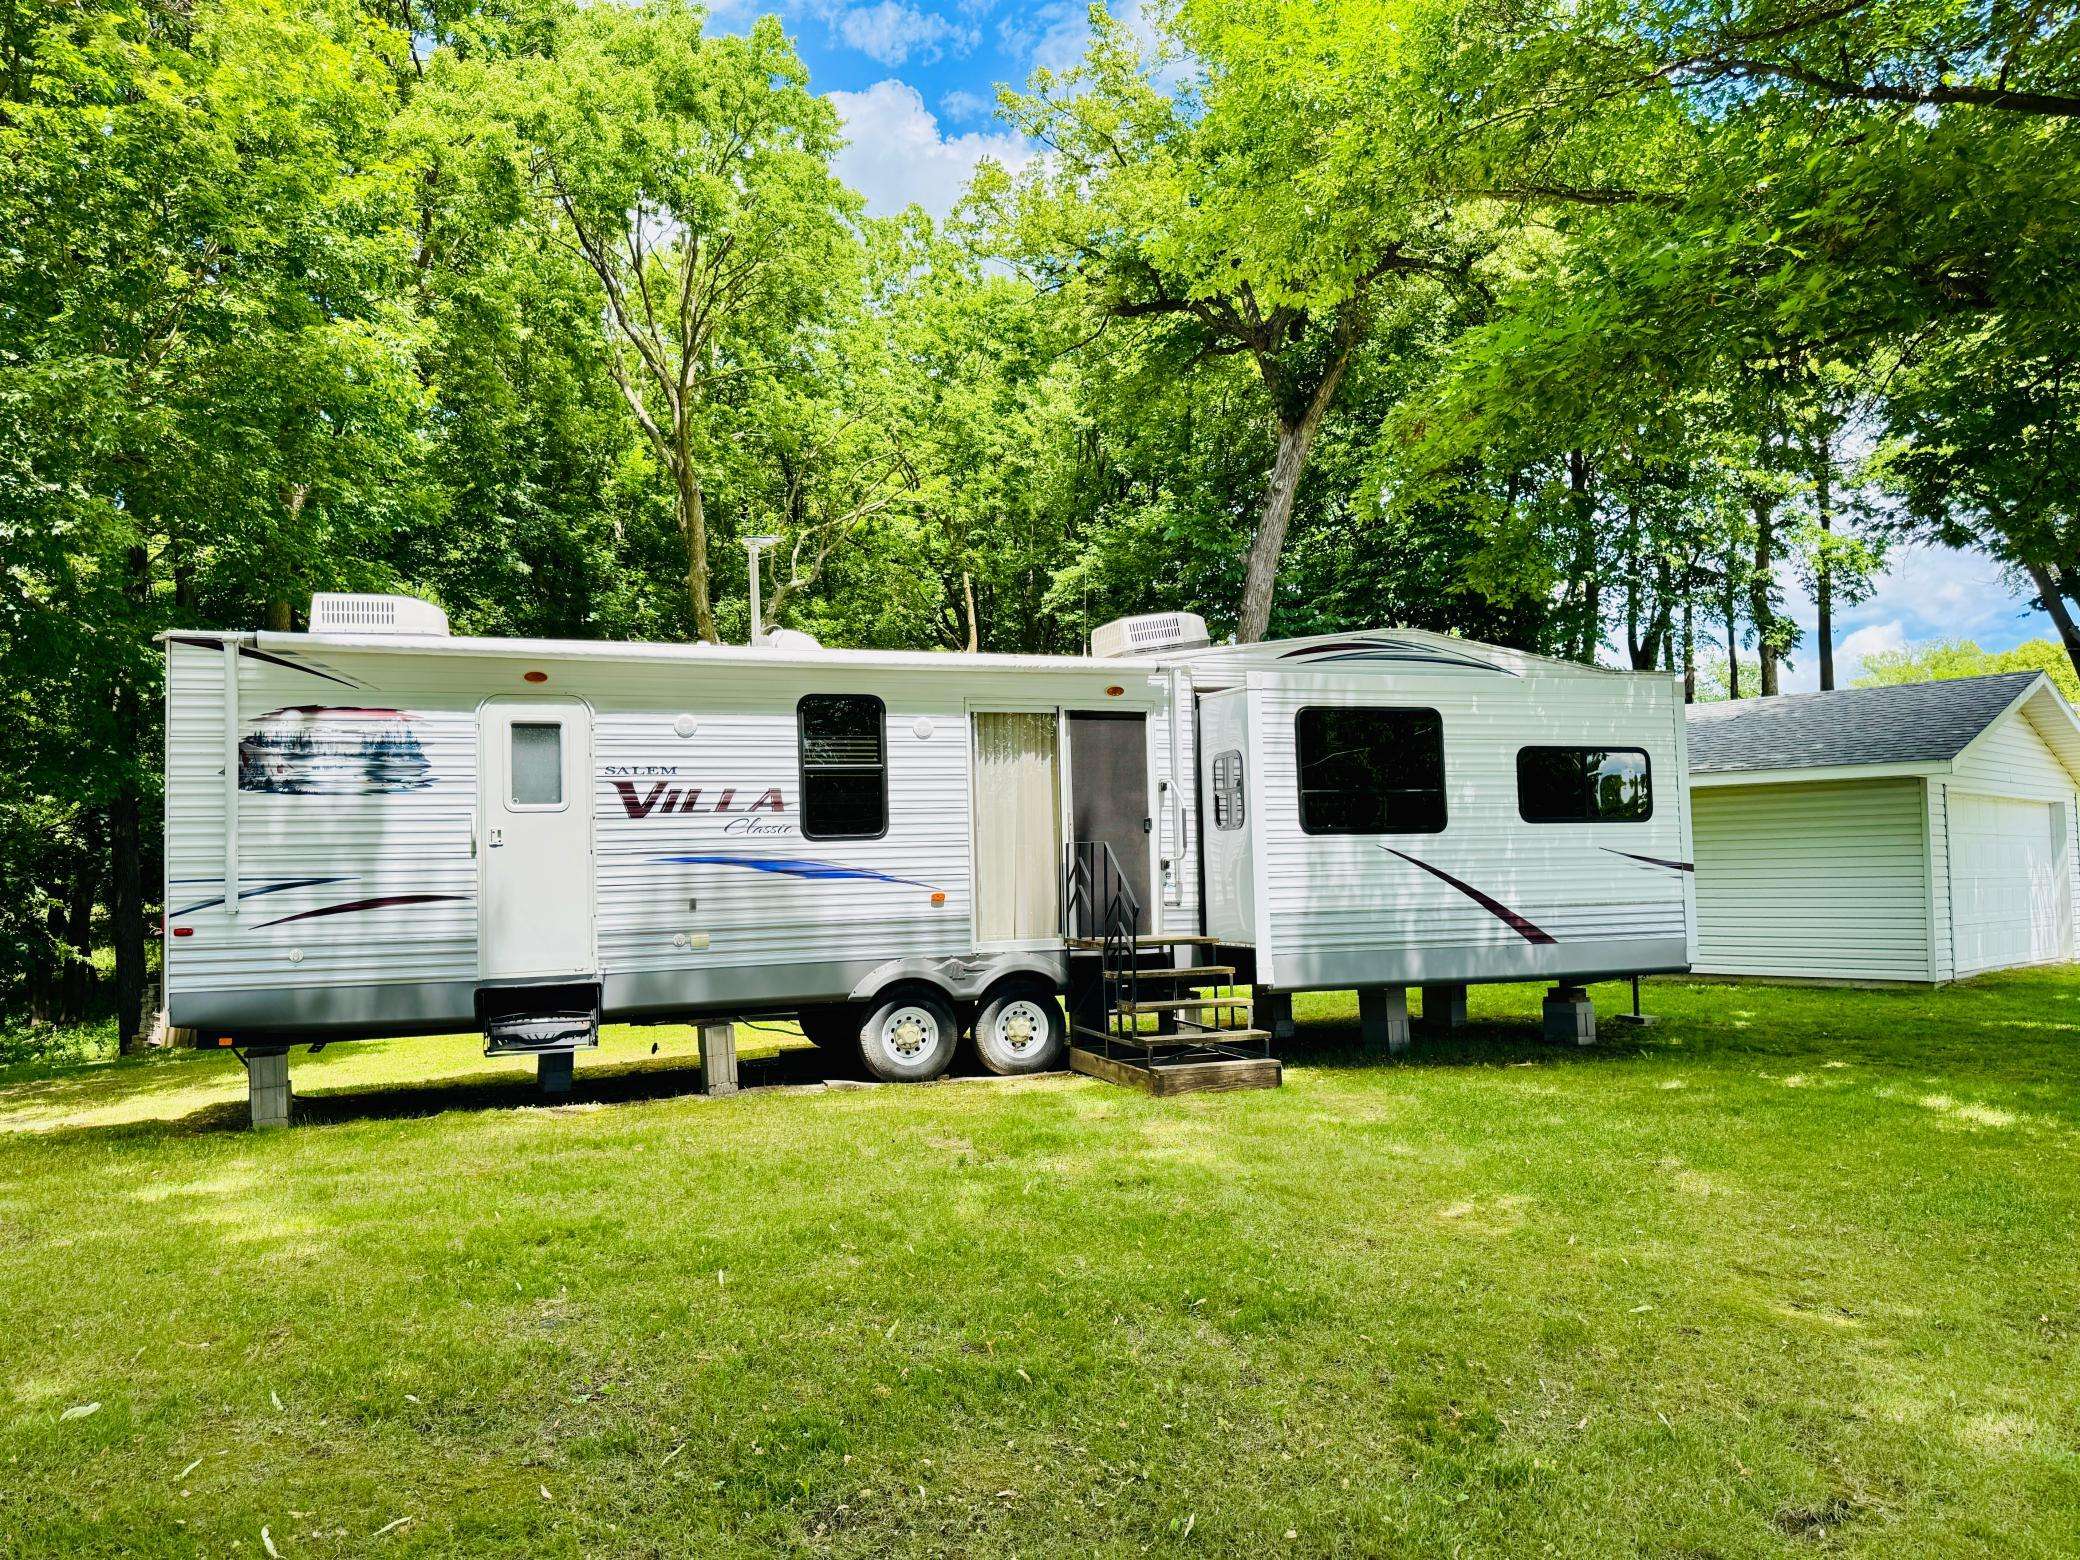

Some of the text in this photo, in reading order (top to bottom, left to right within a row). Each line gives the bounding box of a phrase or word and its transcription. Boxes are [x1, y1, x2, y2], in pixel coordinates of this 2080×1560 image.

[604, 765, 678, 775] SALEM
[608, 780, 786, 819] VILLA
[723, 817, 793, 835] Classic
